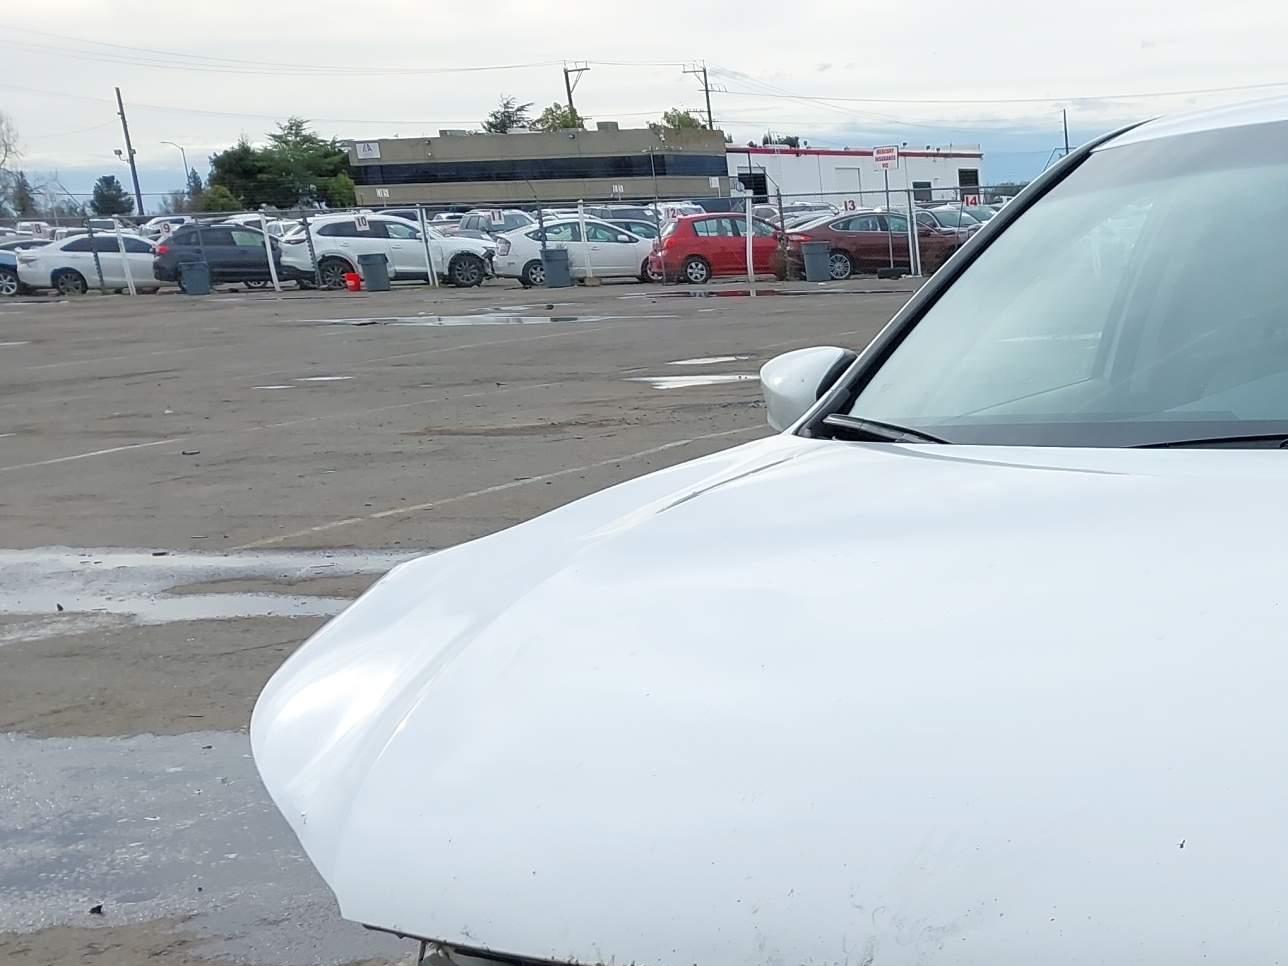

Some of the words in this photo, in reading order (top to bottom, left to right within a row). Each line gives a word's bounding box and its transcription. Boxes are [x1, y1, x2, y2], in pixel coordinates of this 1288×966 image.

[844, 200, 856, 211] 13
[965, 196, 977, 207] 14
[357, 217, 367, 227] 10
[163, 223, 170, 233] 9
